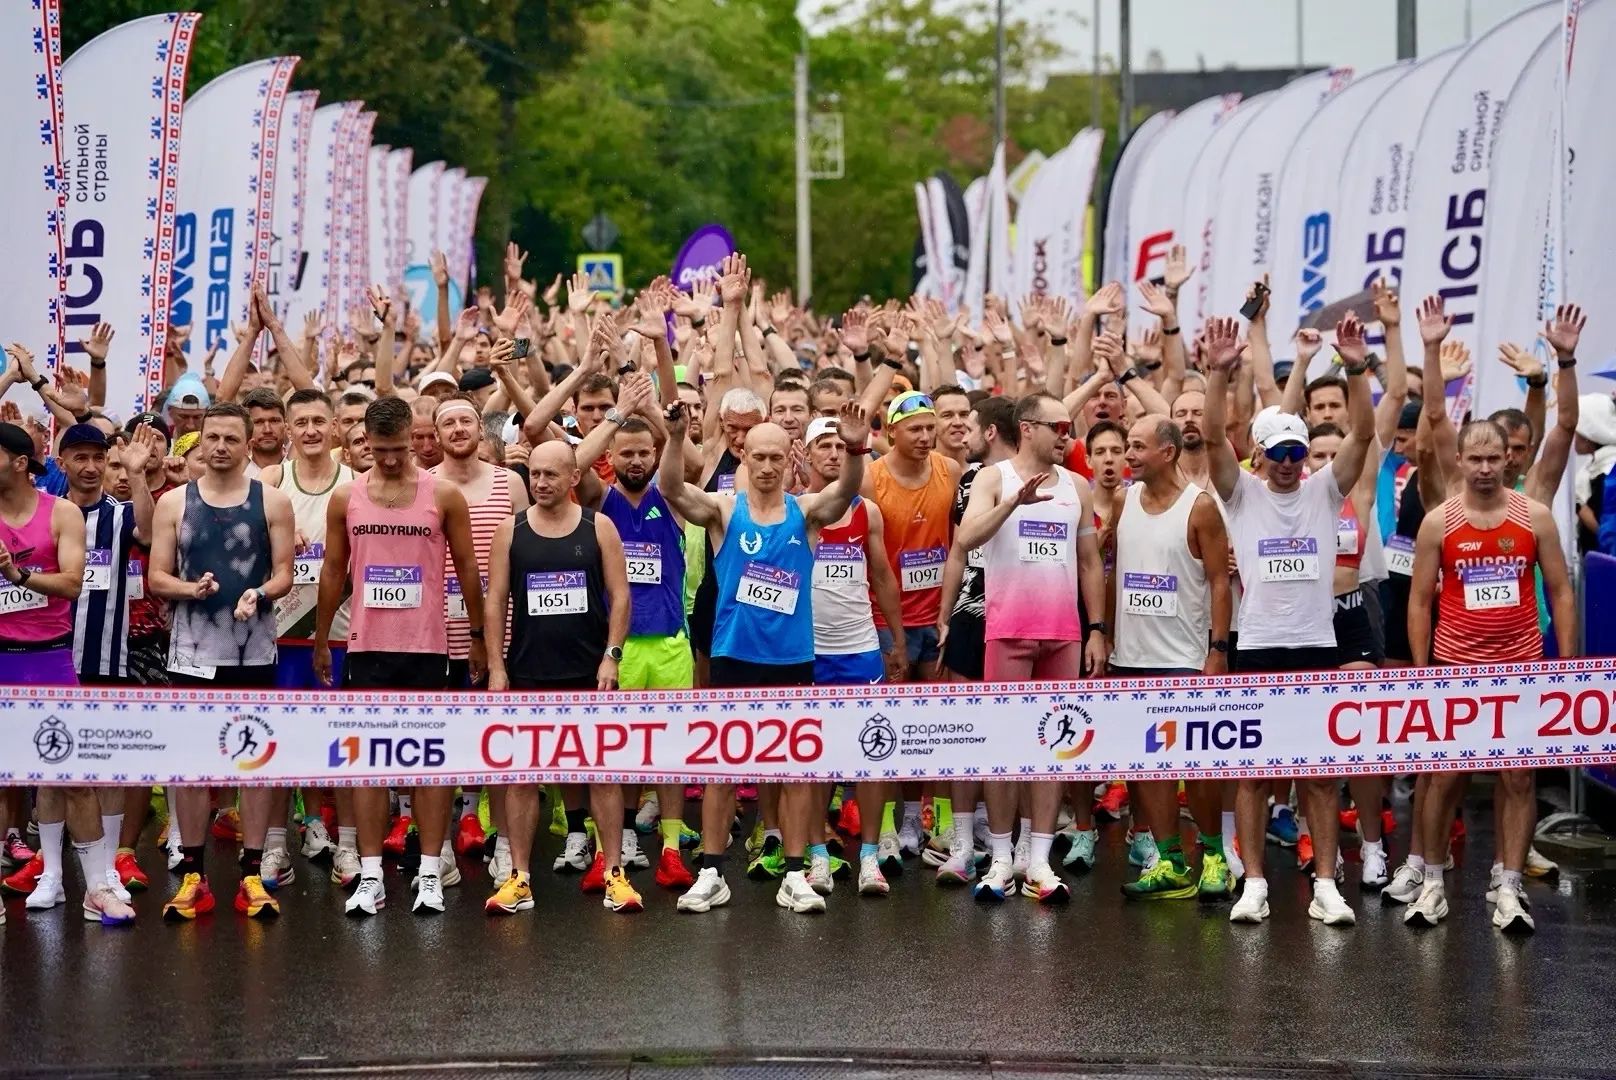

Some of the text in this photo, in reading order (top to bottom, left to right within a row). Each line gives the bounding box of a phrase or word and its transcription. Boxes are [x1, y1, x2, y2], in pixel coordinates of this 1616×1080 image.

[1452, 128, 1468, 174] банк
[76, 124, 91, 202] сильной
[94, 134, 110, 202] страны
[1253, 172, 1273, 265] Медскан
[1028, 541, 1058, 556] 1163
[627, 561, 655, 576] 523
[1267, 558, 1305, 574] 1780
[1390, 553, 1414, 569] 178
[824, 564, 854, 579] 1251
[909, 567, 939, 584] 1097
[371, 587, 406, 602] 1160
[537, 592, 569, 608] 1651
[747, 583, 783, 603] 1657
[1128, 593, 1163, 609] 1560
[1474, 585, 1511, 602] 1873
[1146, 703, 1264, 714] ГЕНЕРАЛЬНЫЙ СПОНСОР
[328, 720, 447, 729] ГЕНЕРАЛЬНЫЙ СПОНСОР
[1037, 703, 1093, 746] RUSSIA RUNNING
[1327, 689, 1616, 747] СТАРТ 20
[480, 717, 824, 769] СТАРТ 2026
[942, 736, 987, 744] ЗОЛОТОМУ
[1185, 719, 1263, 751] ПСБ
[369, 737, 446, 767] ПСБ
[901, 748, 934, 756] КОЛЬЦУ
